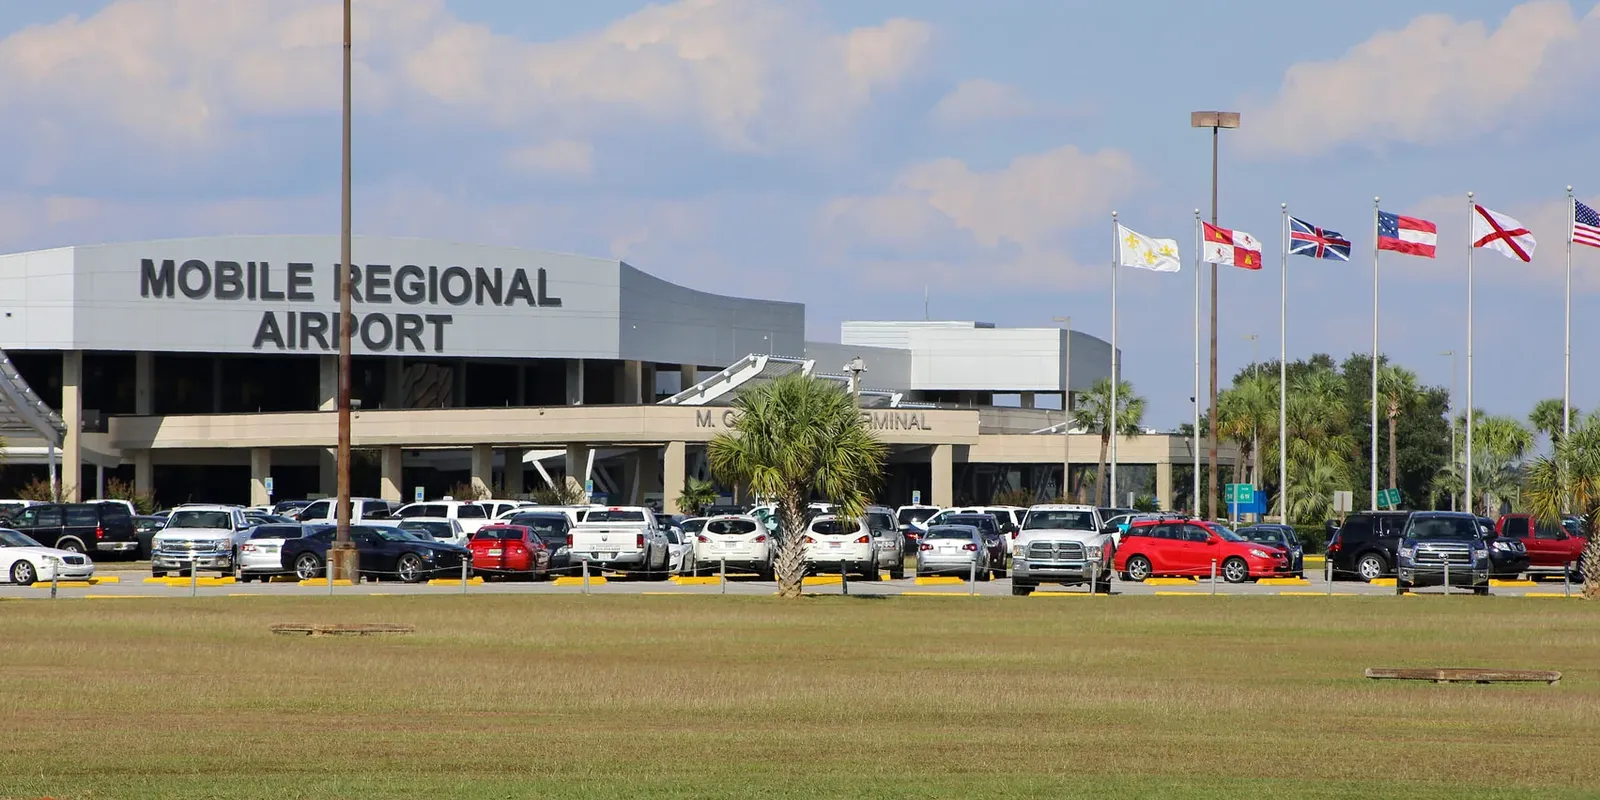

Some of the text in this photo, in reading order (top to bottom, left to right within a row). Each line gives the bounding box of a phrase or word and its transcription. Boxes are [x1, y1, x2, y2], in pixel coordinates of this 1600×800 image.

[140, 258, 562, 307] MOBILE REGIONAL
[252, 311, 453, 352] AIRPORT
[696, 409, 715, 428] M.
[859, 411, 932, 431] RMINAL
